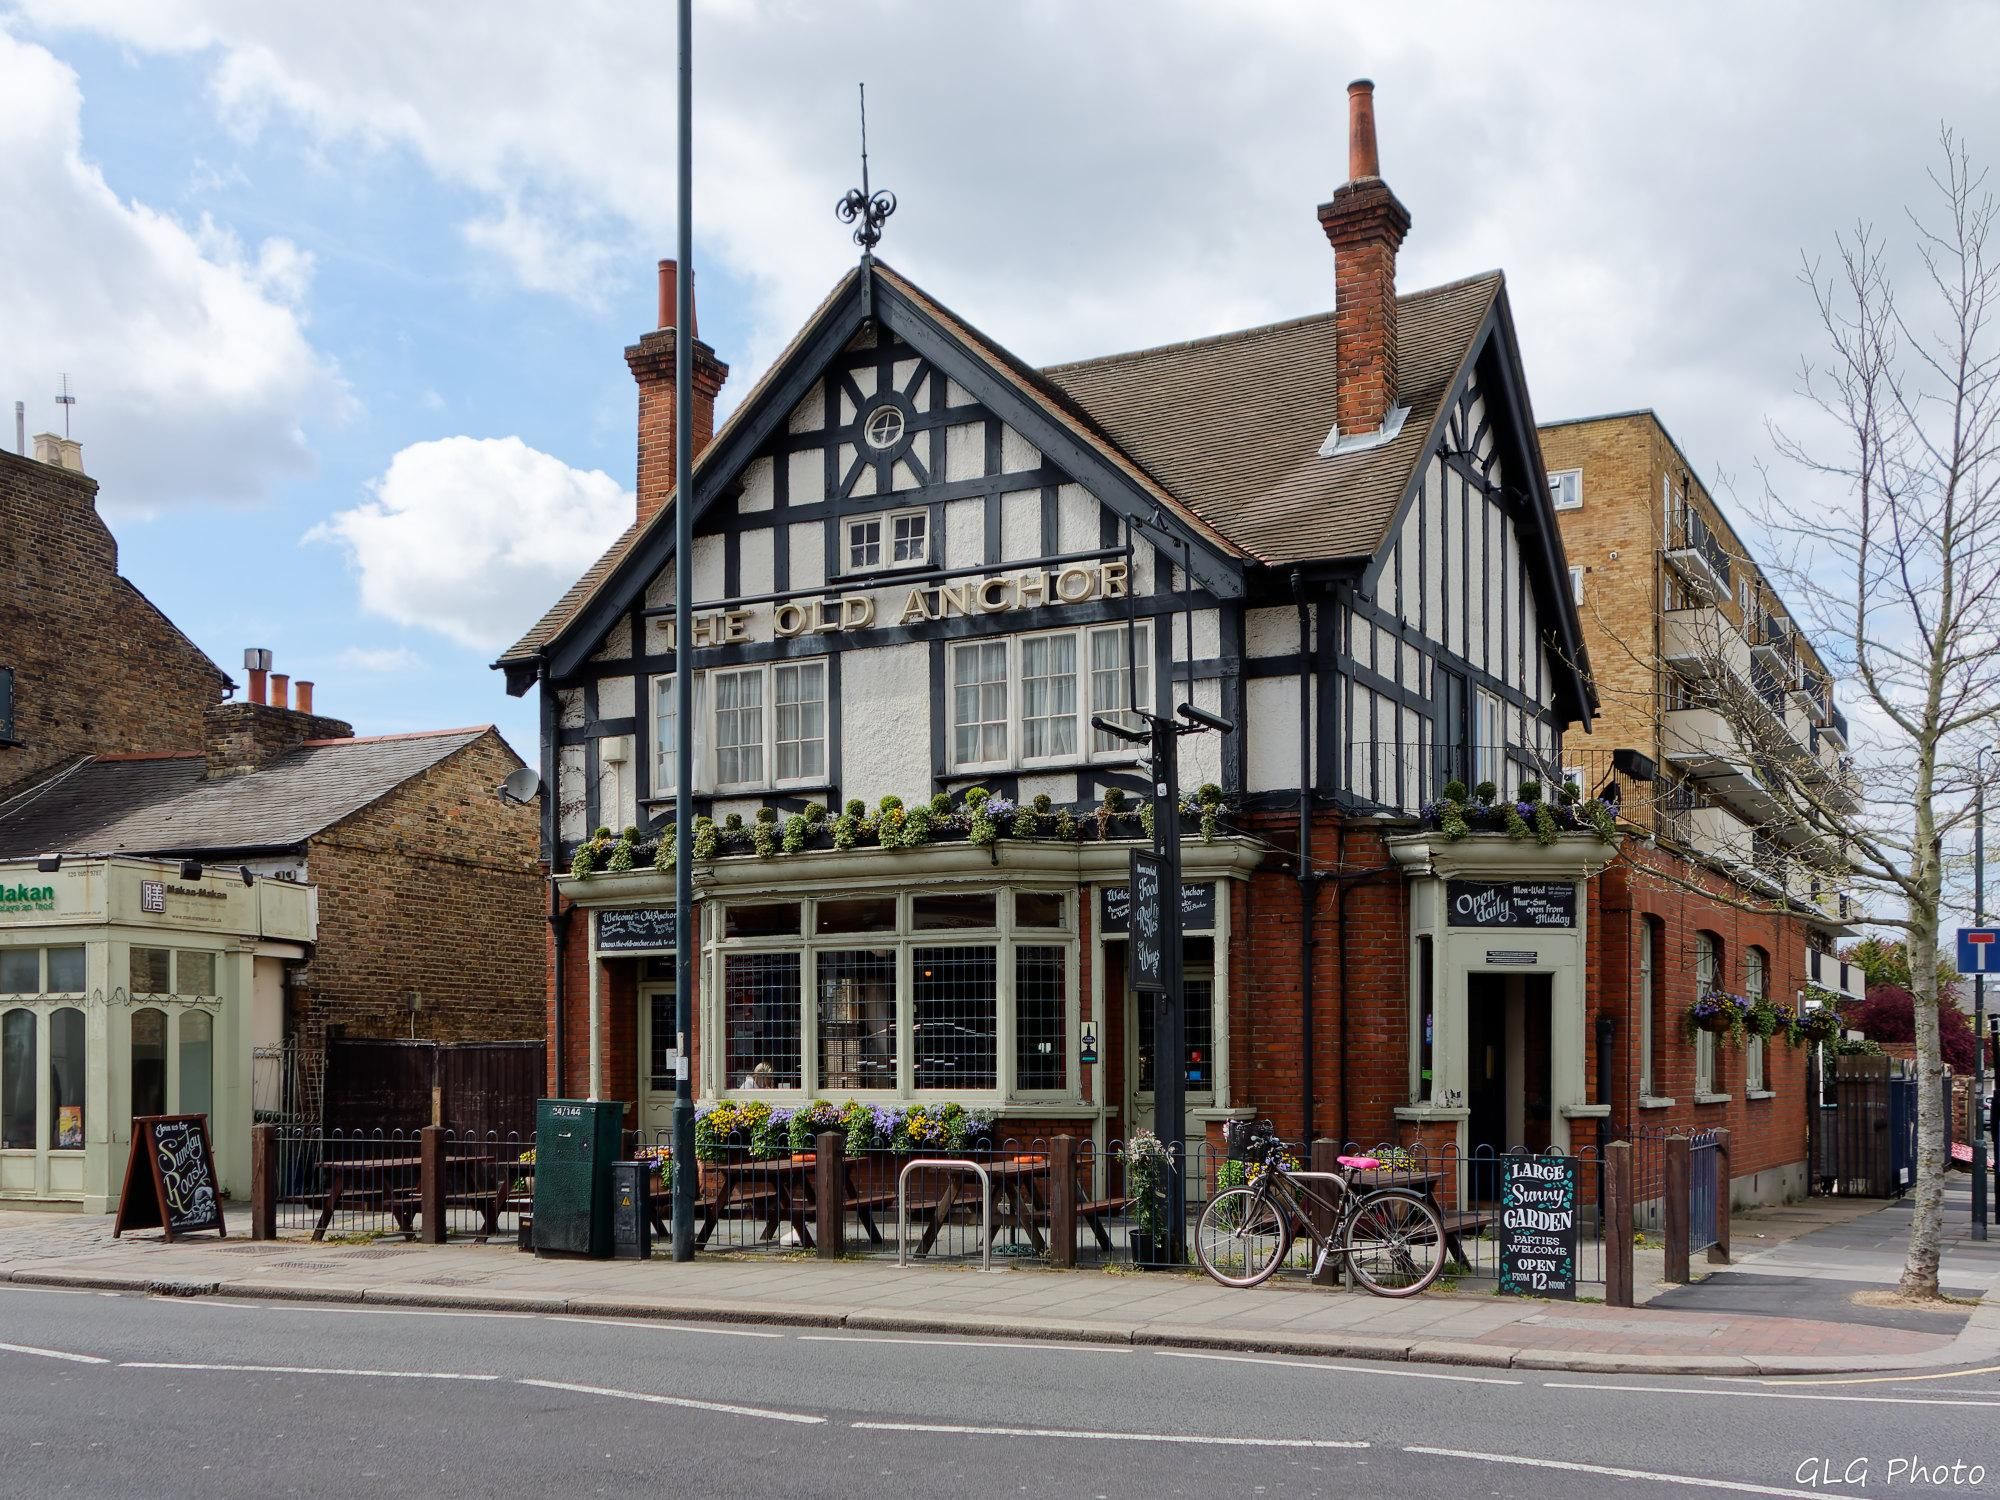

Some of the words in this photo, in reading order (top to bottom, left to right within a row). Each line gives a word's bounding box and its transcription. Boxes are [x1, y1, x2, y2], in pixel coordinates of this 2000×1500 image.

[656, 610, 755, 653] THE
[773, 595, 875, 638] OLD
[900, 562, 1129, 623] ANCHOR
[166, 885, 228, 899] Makan-Makan
[1139, 876, 1158, 901] Food
[1513, 886, 1546, 894] Mon-Wed
[1456, 888, 1495, 915] Open
[1476, 895, 1517, 923] daily
[1513, 897, 1547, 906] Thur-Sun
[1526, 907, 1544, 915] open
[1545, 904, 1564, 913] from
[603, 912, 634, 923] Welcome
[640, 910, 653, 921] Old
[653, 910, 676, 920] Anchor
[1535, 914, 1570, 926] Midday
[1139, 944, 1160, 971] Wines
[158, 1128, 202, 1174] Sunday
[1512, 1162, 1565, 1181] LARGE
[164, 1160, 206, 1215] Roast
[1512, 1183, 1564, 1209] Sunny
[1503, 1208, 1573, 1232] GARDEN
[1514, 1235, 1560, 1245] PARTIES
[1507, 1244, 1567, 1256] WELCOME
[1517, 1258, 1557, 1272] OPEN
[1512, 1273, 1530, 1282] FROM
[1531, 1272, 1547, 1290] 12
[1548, 1281, 1566, 1290] NOON
